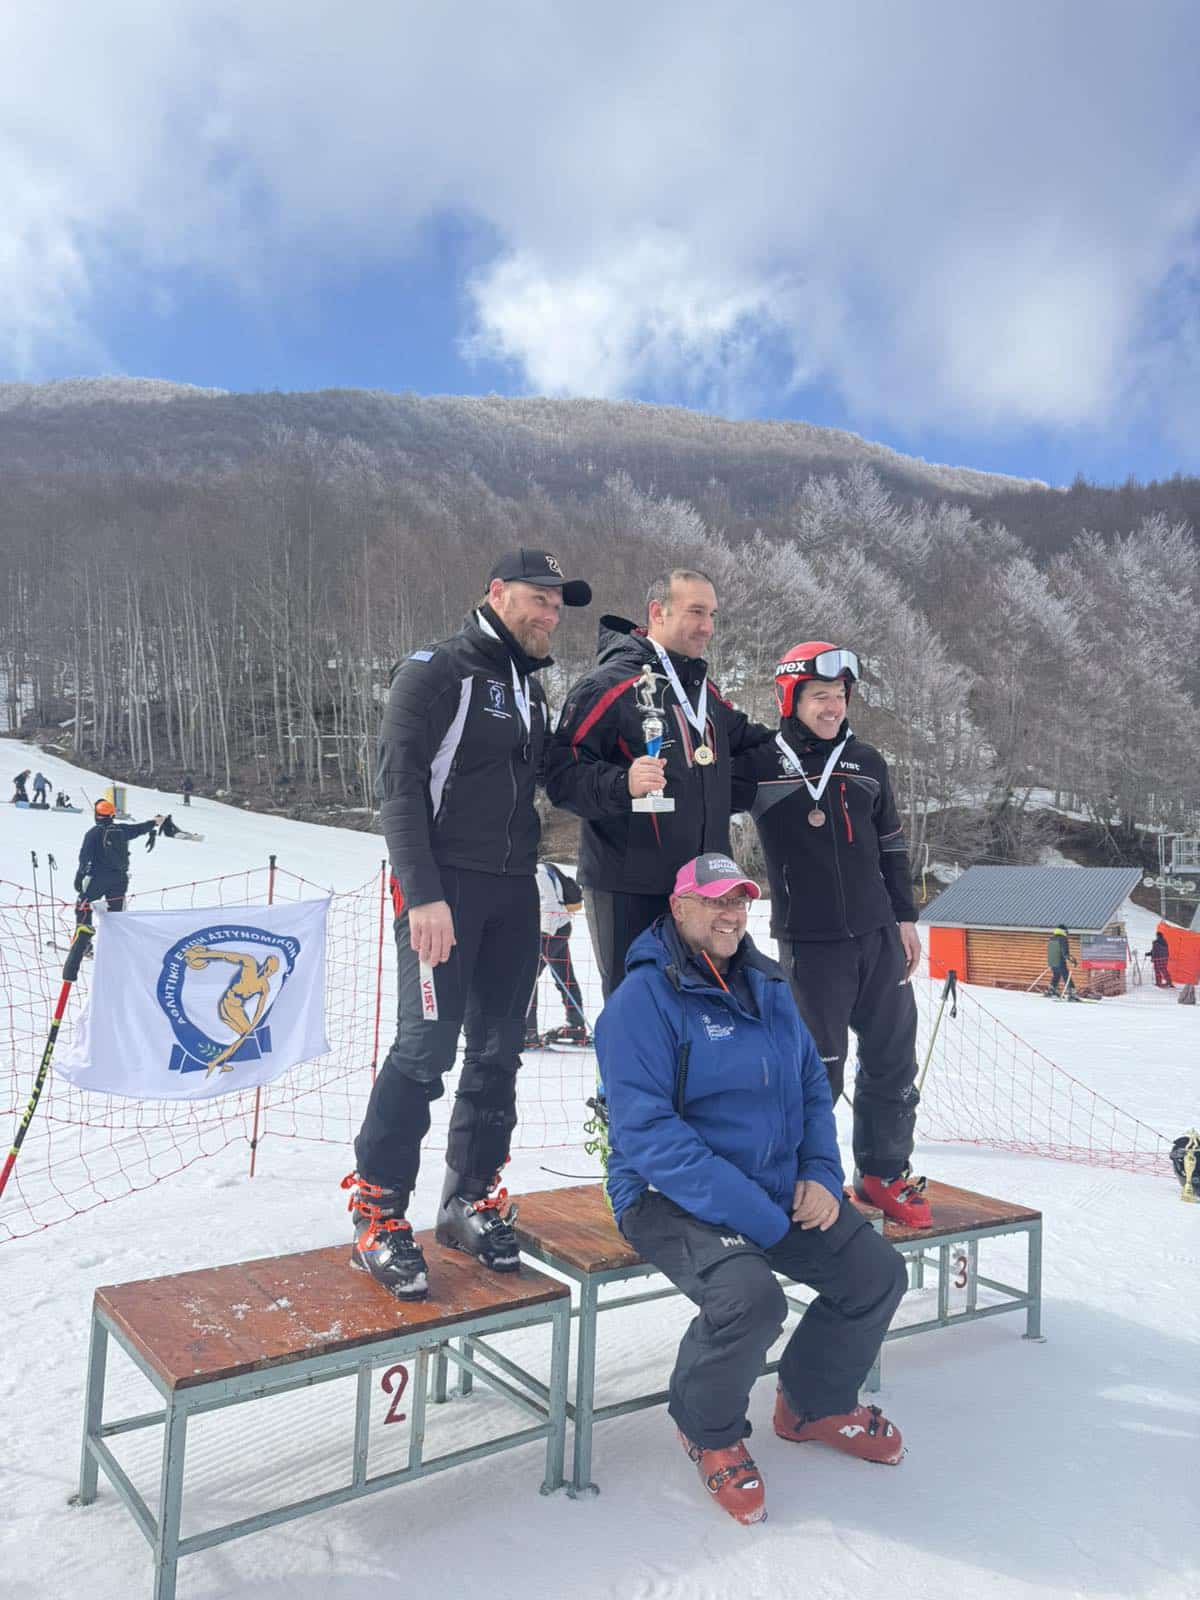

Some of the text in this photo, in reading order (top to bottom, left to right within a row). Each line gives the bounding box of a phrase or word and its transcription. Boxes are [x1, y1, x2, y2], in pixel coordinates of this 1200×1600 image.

[165, 962, 187, 1024] ΑΘΛΗΤΙΚΗ
[208, 930, 297, 958] ΑΣΤΥΝΟΜΙΚΩΝ
[954, 1256, 967, 1288] 3
[381, 1365, 408, 1424] 2
